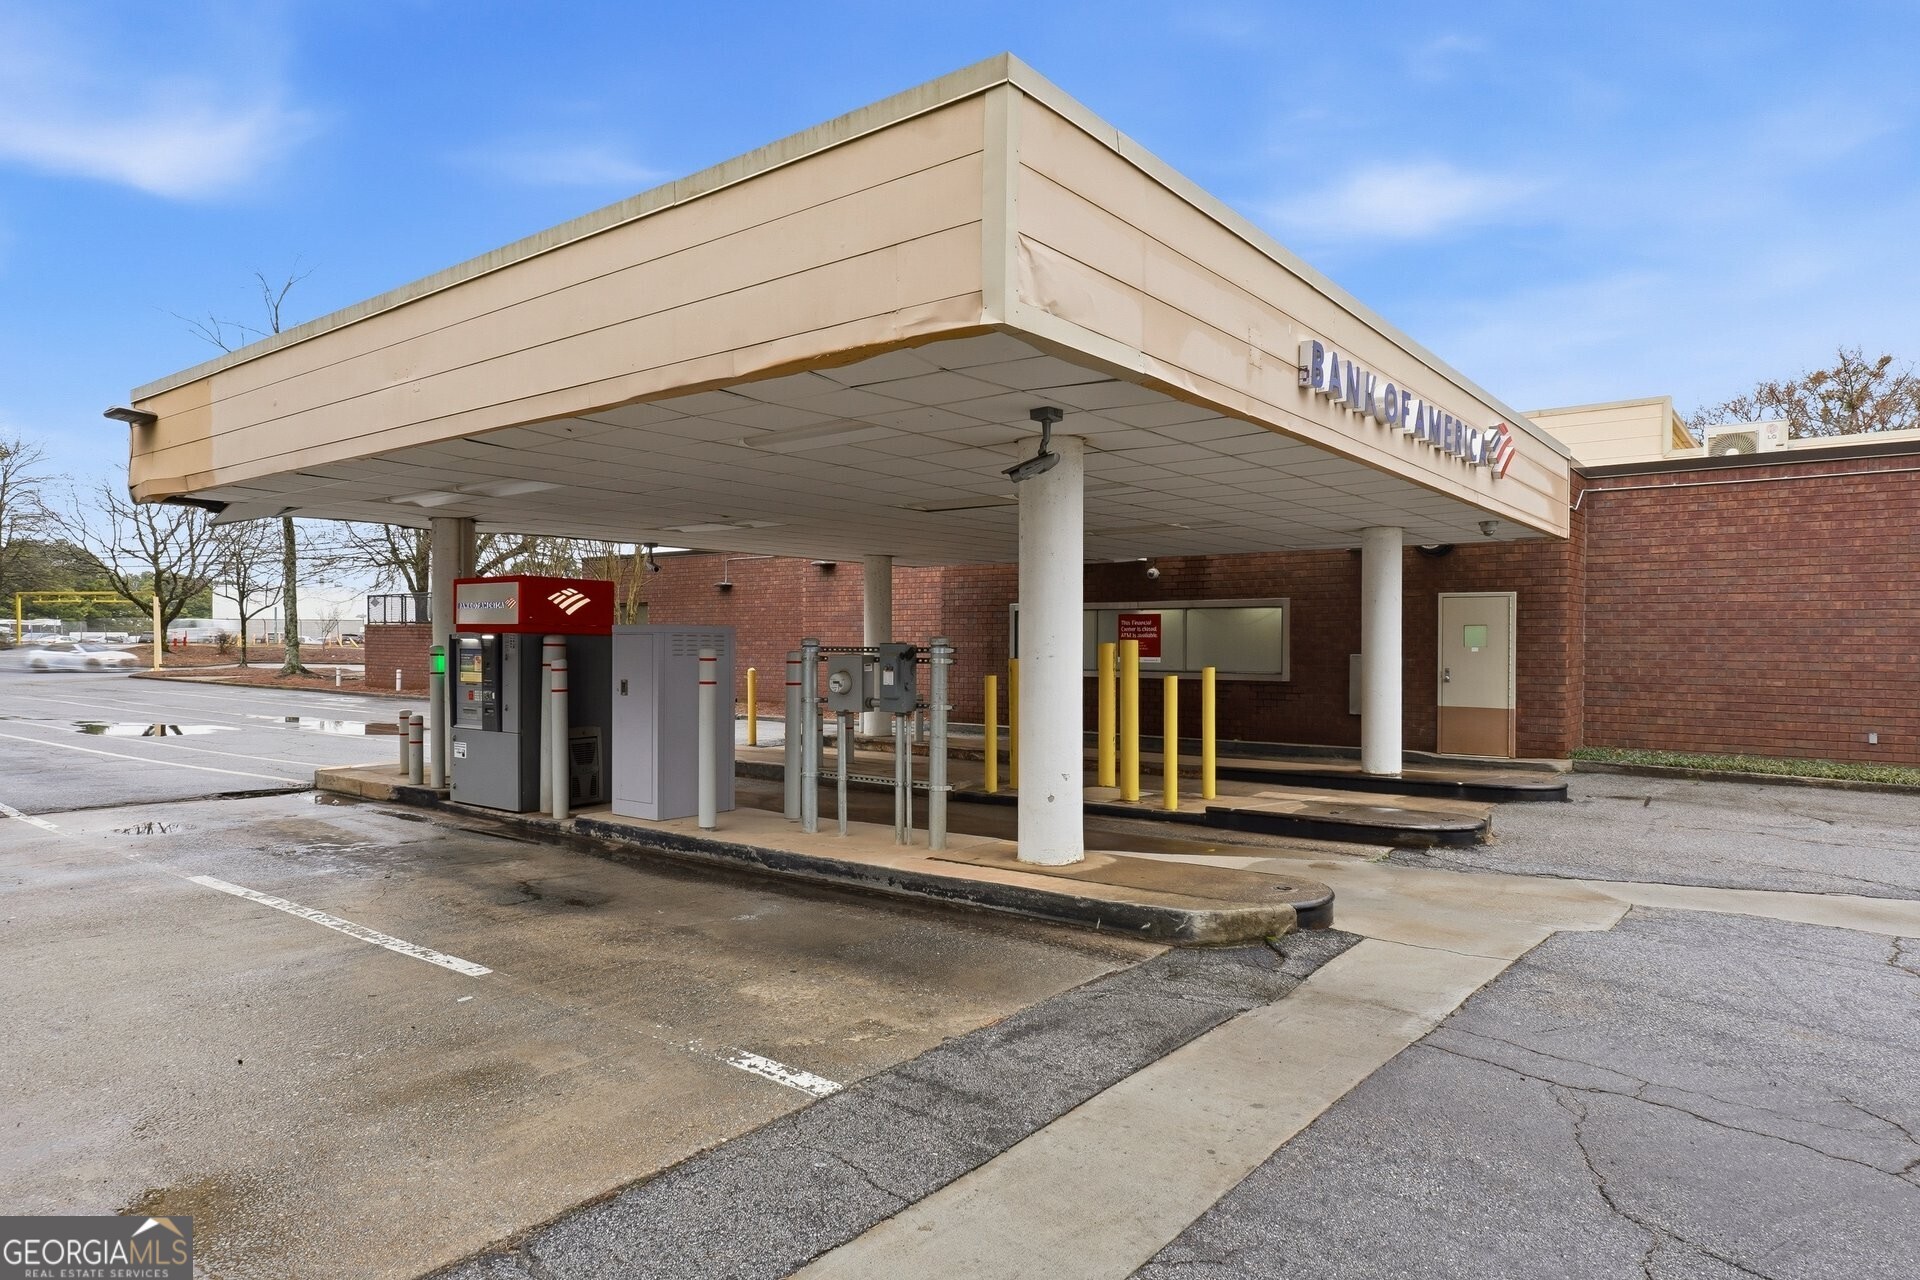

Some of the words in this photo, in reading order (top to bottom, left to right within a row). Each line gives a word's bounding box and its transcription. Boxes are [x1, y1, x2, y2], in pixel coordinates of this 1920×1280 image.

[1301, 339, 1378, 417] BANK
[1383, 382, 1412, 429] OF
[1410, 399, 1488, 467] AMERICA
